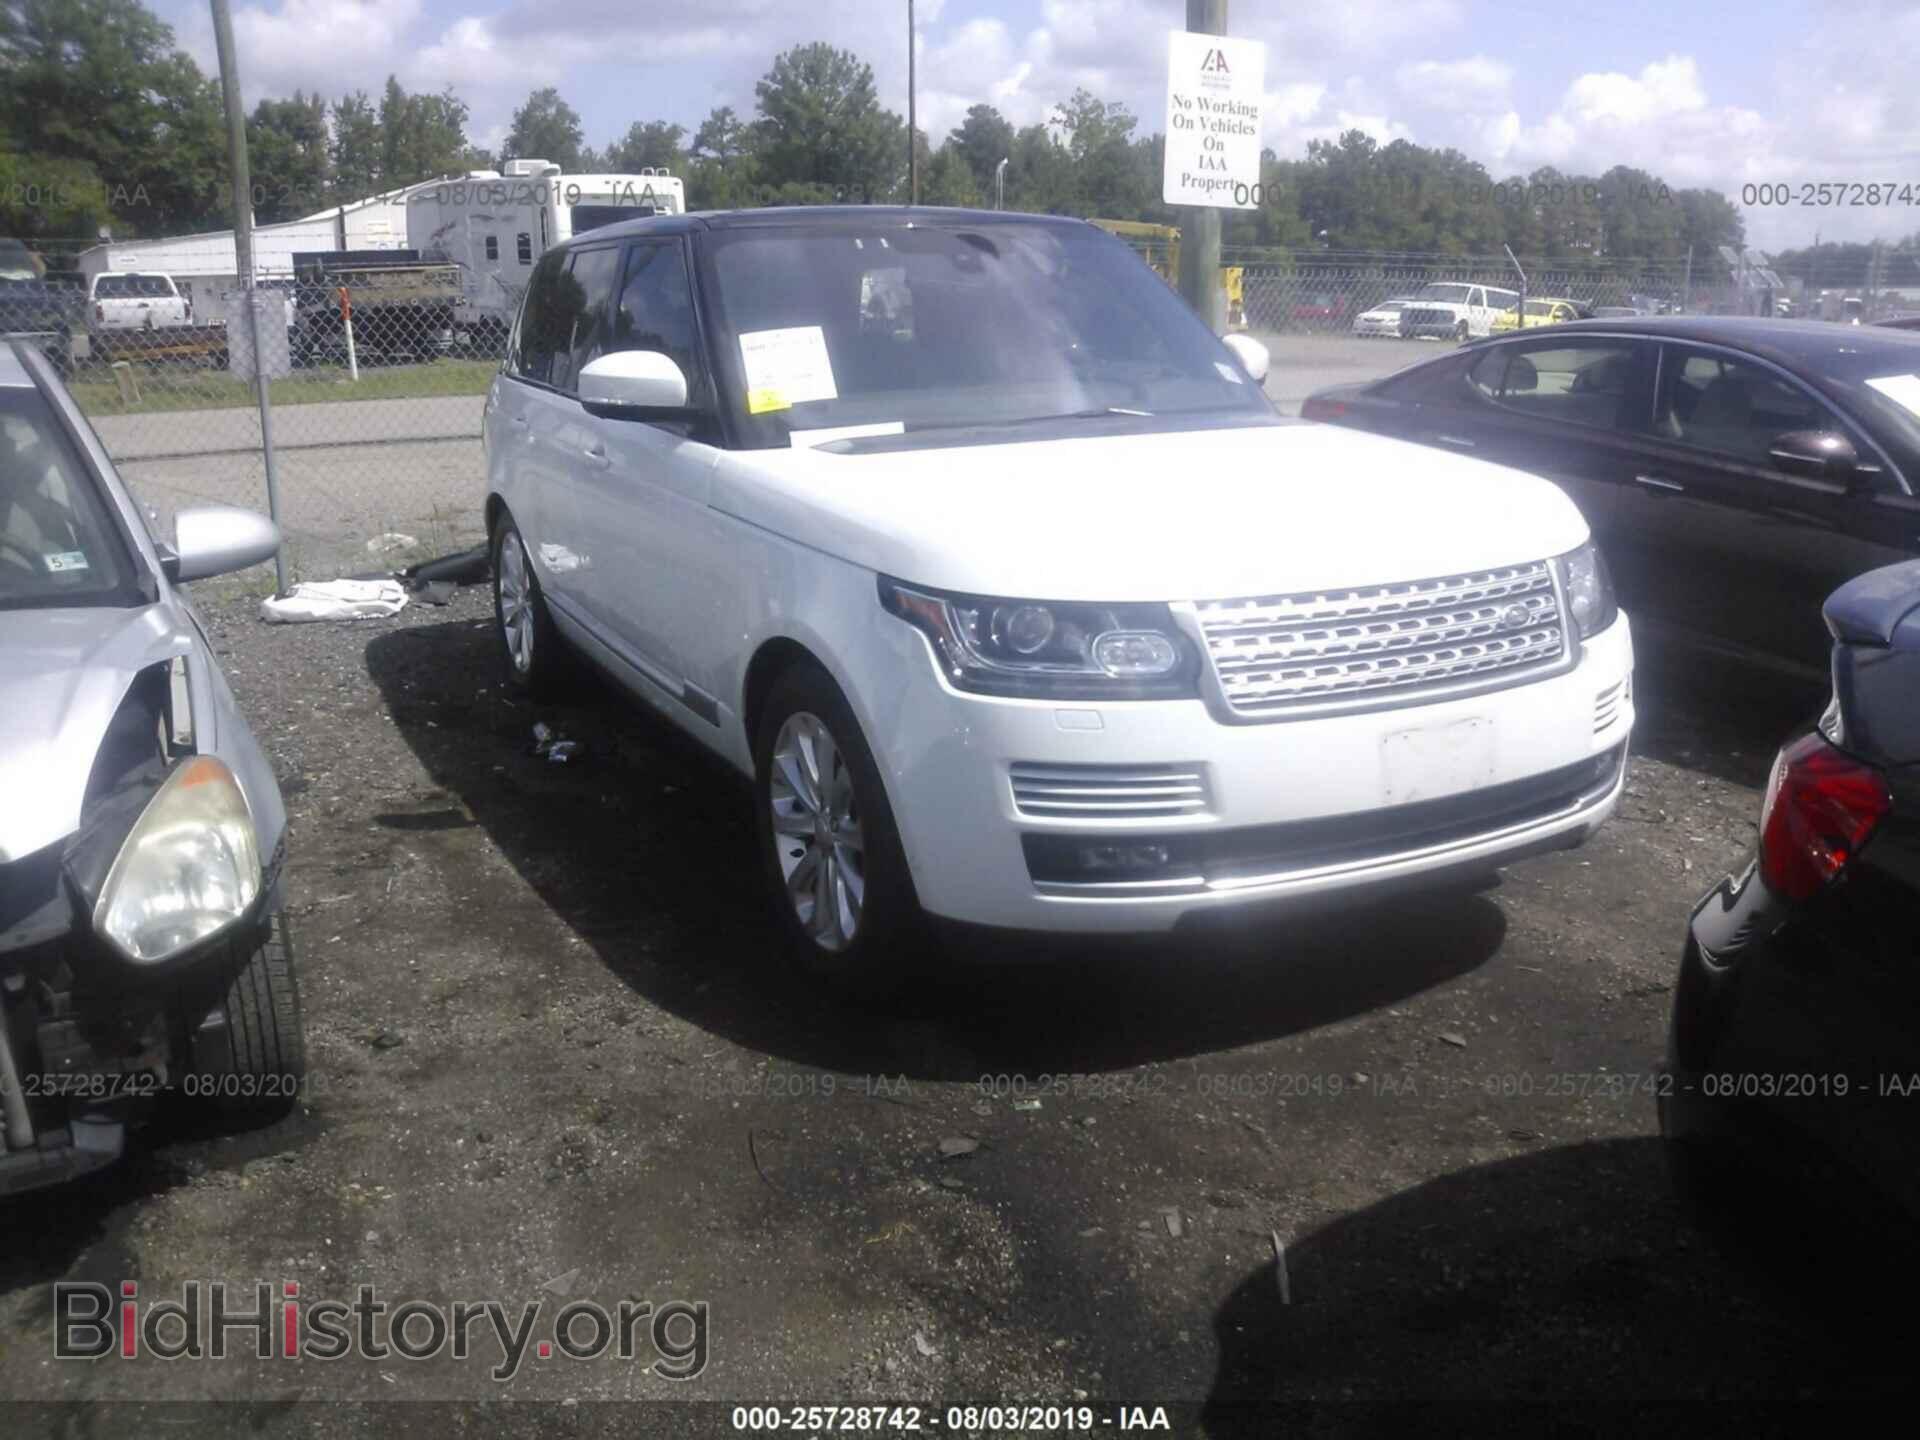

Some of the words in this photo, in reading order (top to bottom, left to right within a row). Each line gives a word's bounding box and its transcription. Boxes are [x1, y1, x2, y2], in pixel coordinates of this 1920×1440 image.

[1172, 94, 1192, 110] No
[1197, 96, 1258, 119] Working
[1172, 113, 1194, 130] On
[1199, 116, 1256, 136] Vehicles
[1203, 135, 1224, 151] On
[1198, 155, 1227, 171] IAA
